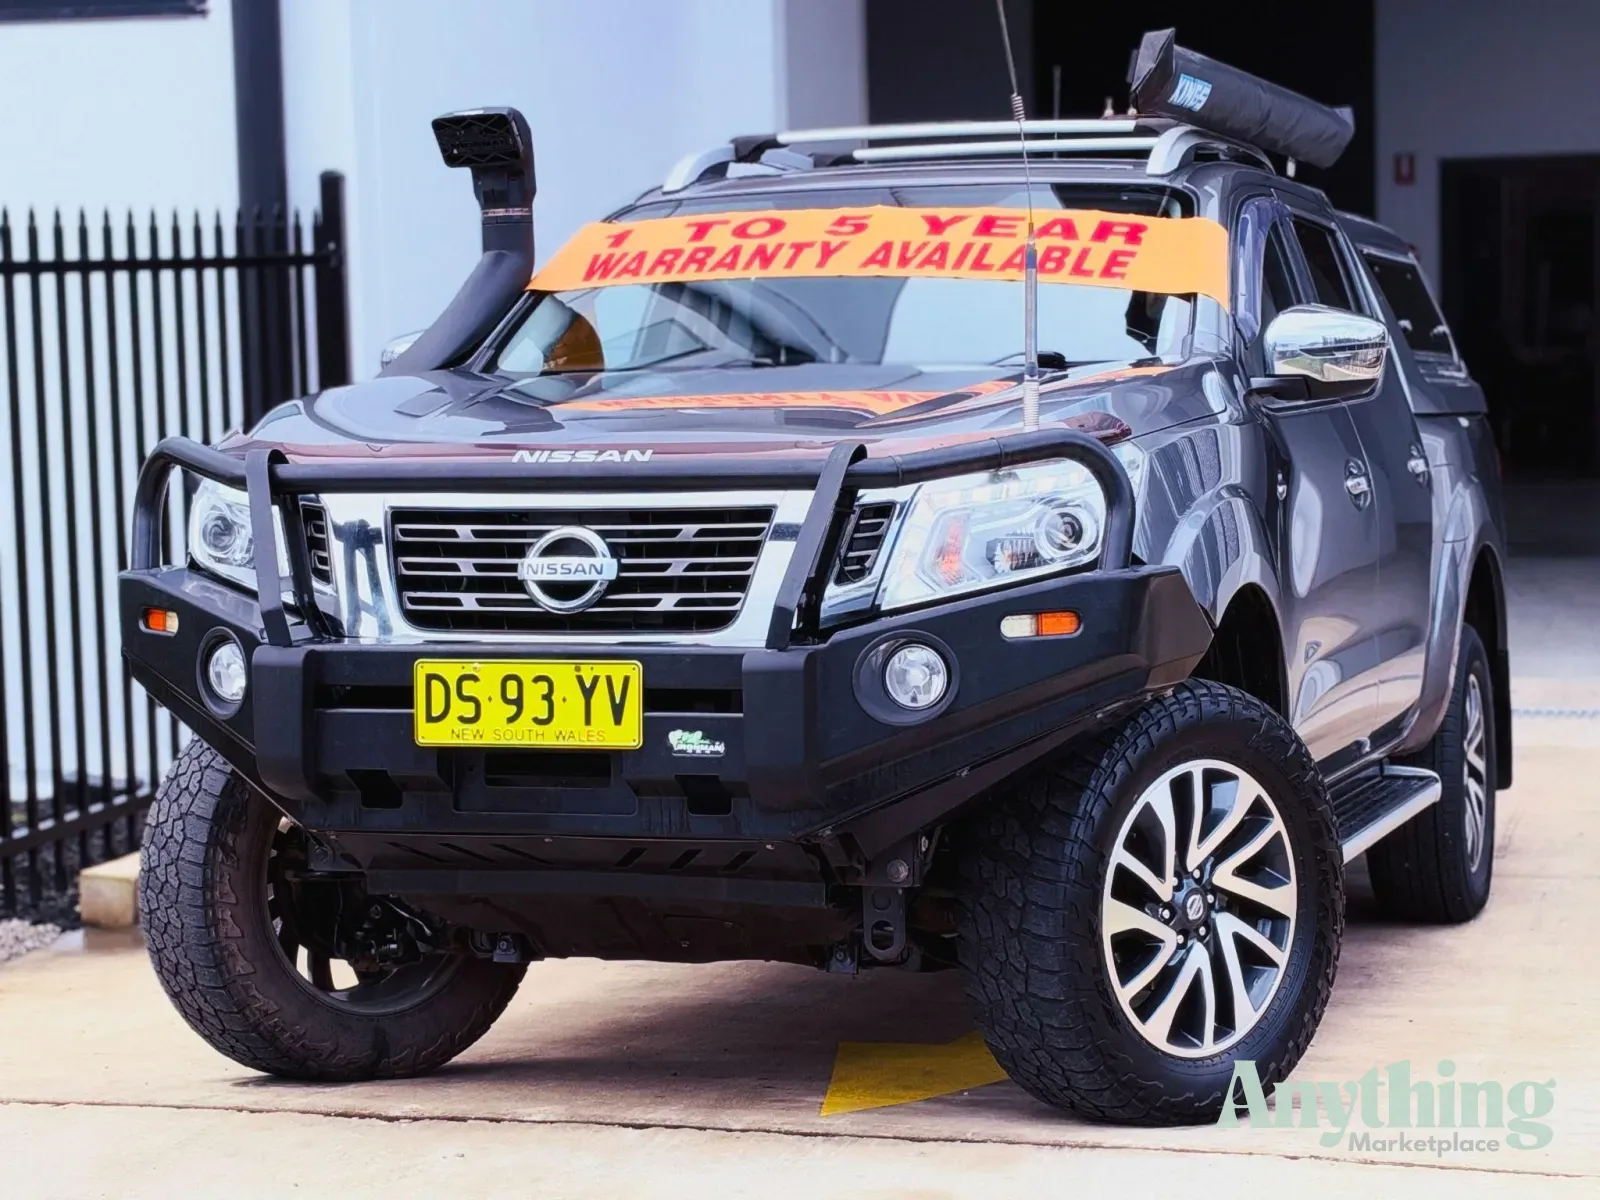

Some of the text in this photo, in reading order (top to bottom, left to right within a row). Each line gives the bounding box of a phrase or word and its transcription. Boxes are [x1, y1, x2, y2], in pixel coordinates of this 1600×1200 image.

[605, 214, 1149, 248] 1 TO 5 YEAR
[581, 241, 1139, 282] WARRANTY AVAILABLE
[511, 449, 654, 463] NISSAN
[526, 563, 604, 575] NISSAN
[451, 728, 606, 742] NEW SOUTH WALES
